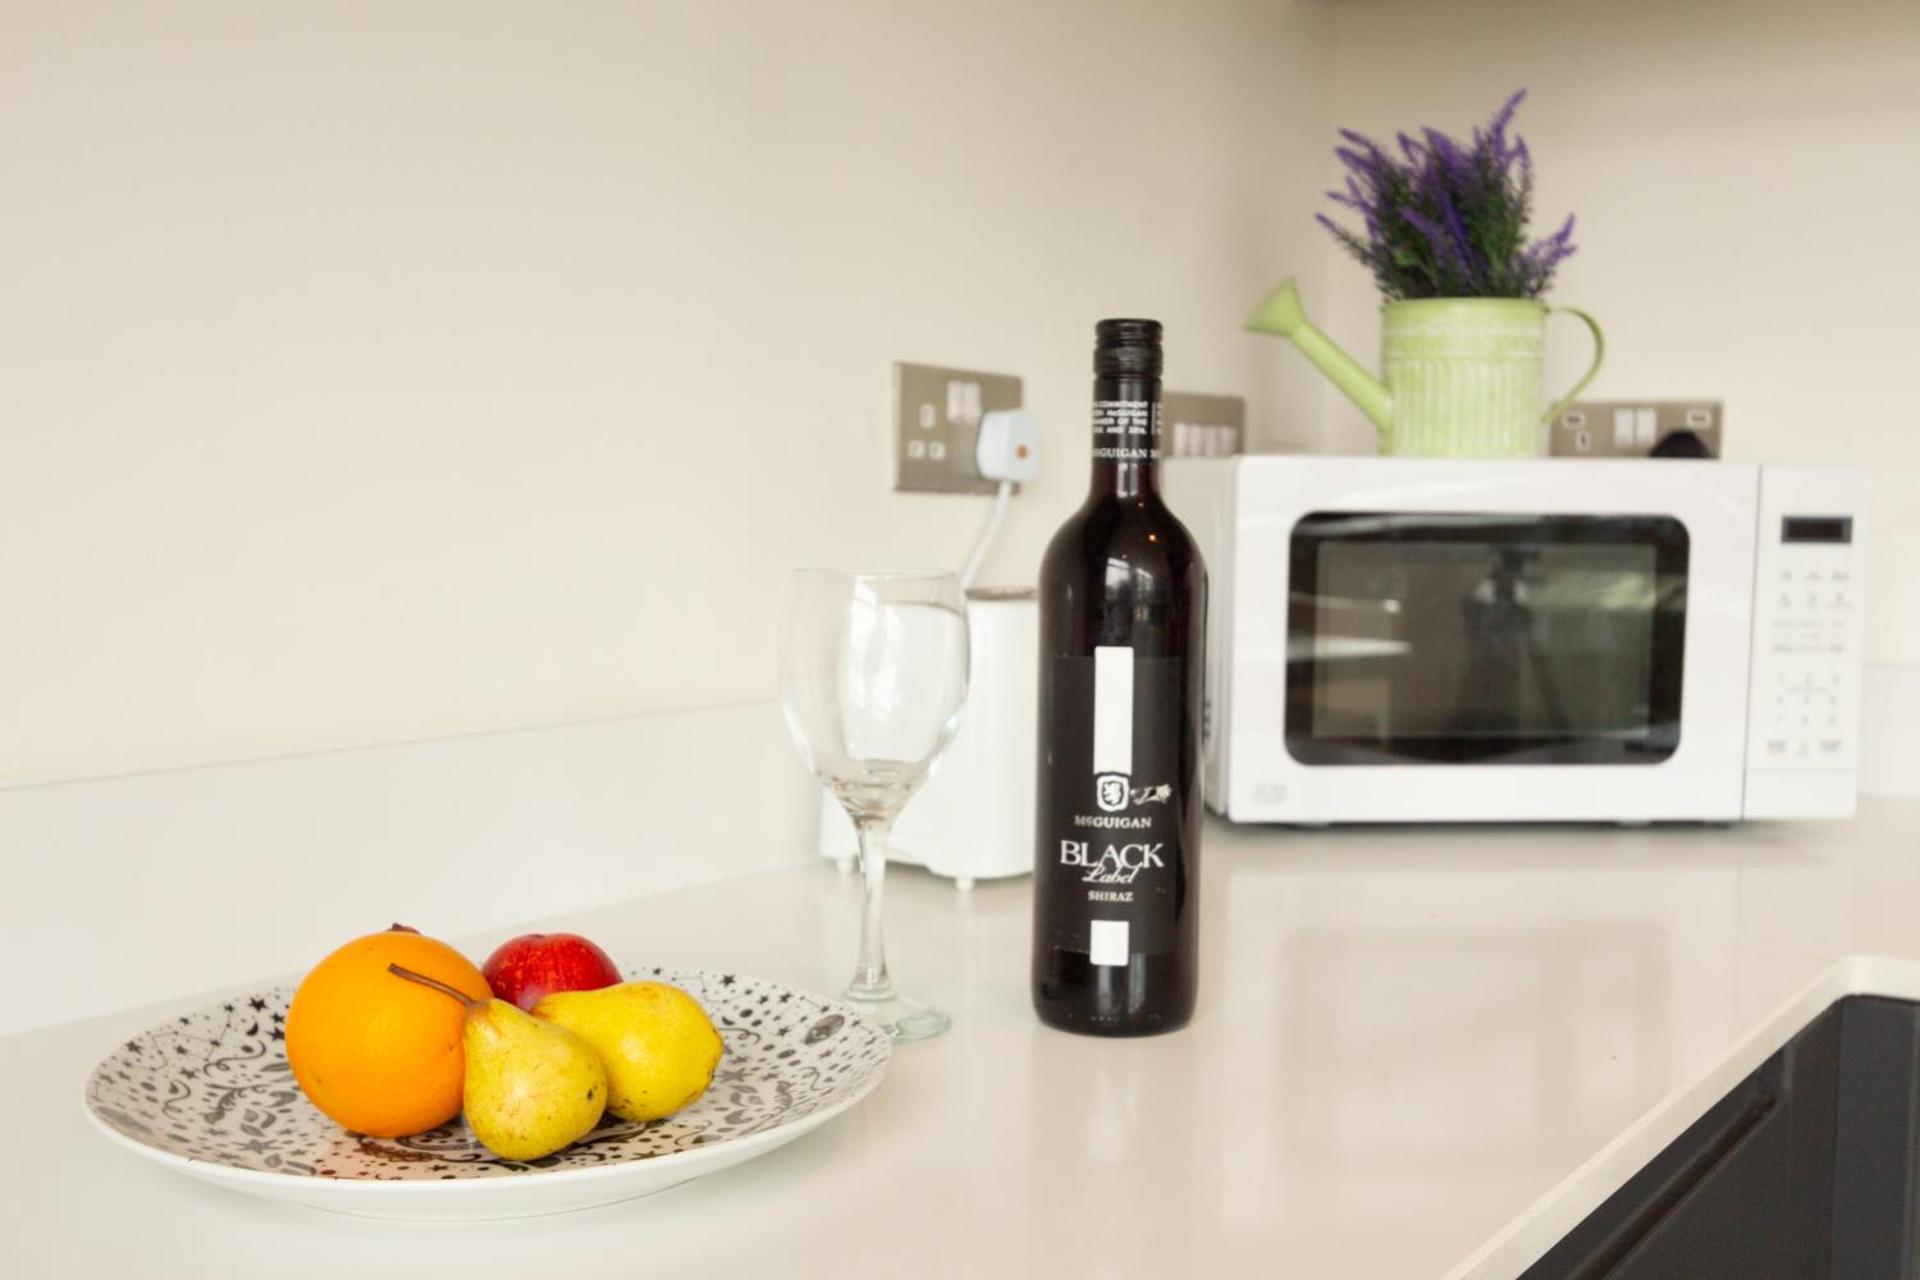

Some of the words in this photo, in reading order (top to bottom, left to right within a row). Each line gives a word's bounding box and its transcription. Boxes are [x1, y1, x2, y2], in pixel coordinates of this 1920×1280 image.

[1060, 839, 1165, 869] BLACK
[1081, 863, 1143, 884] Label
[1088, 890, 1134, 902] SHIRAZ
